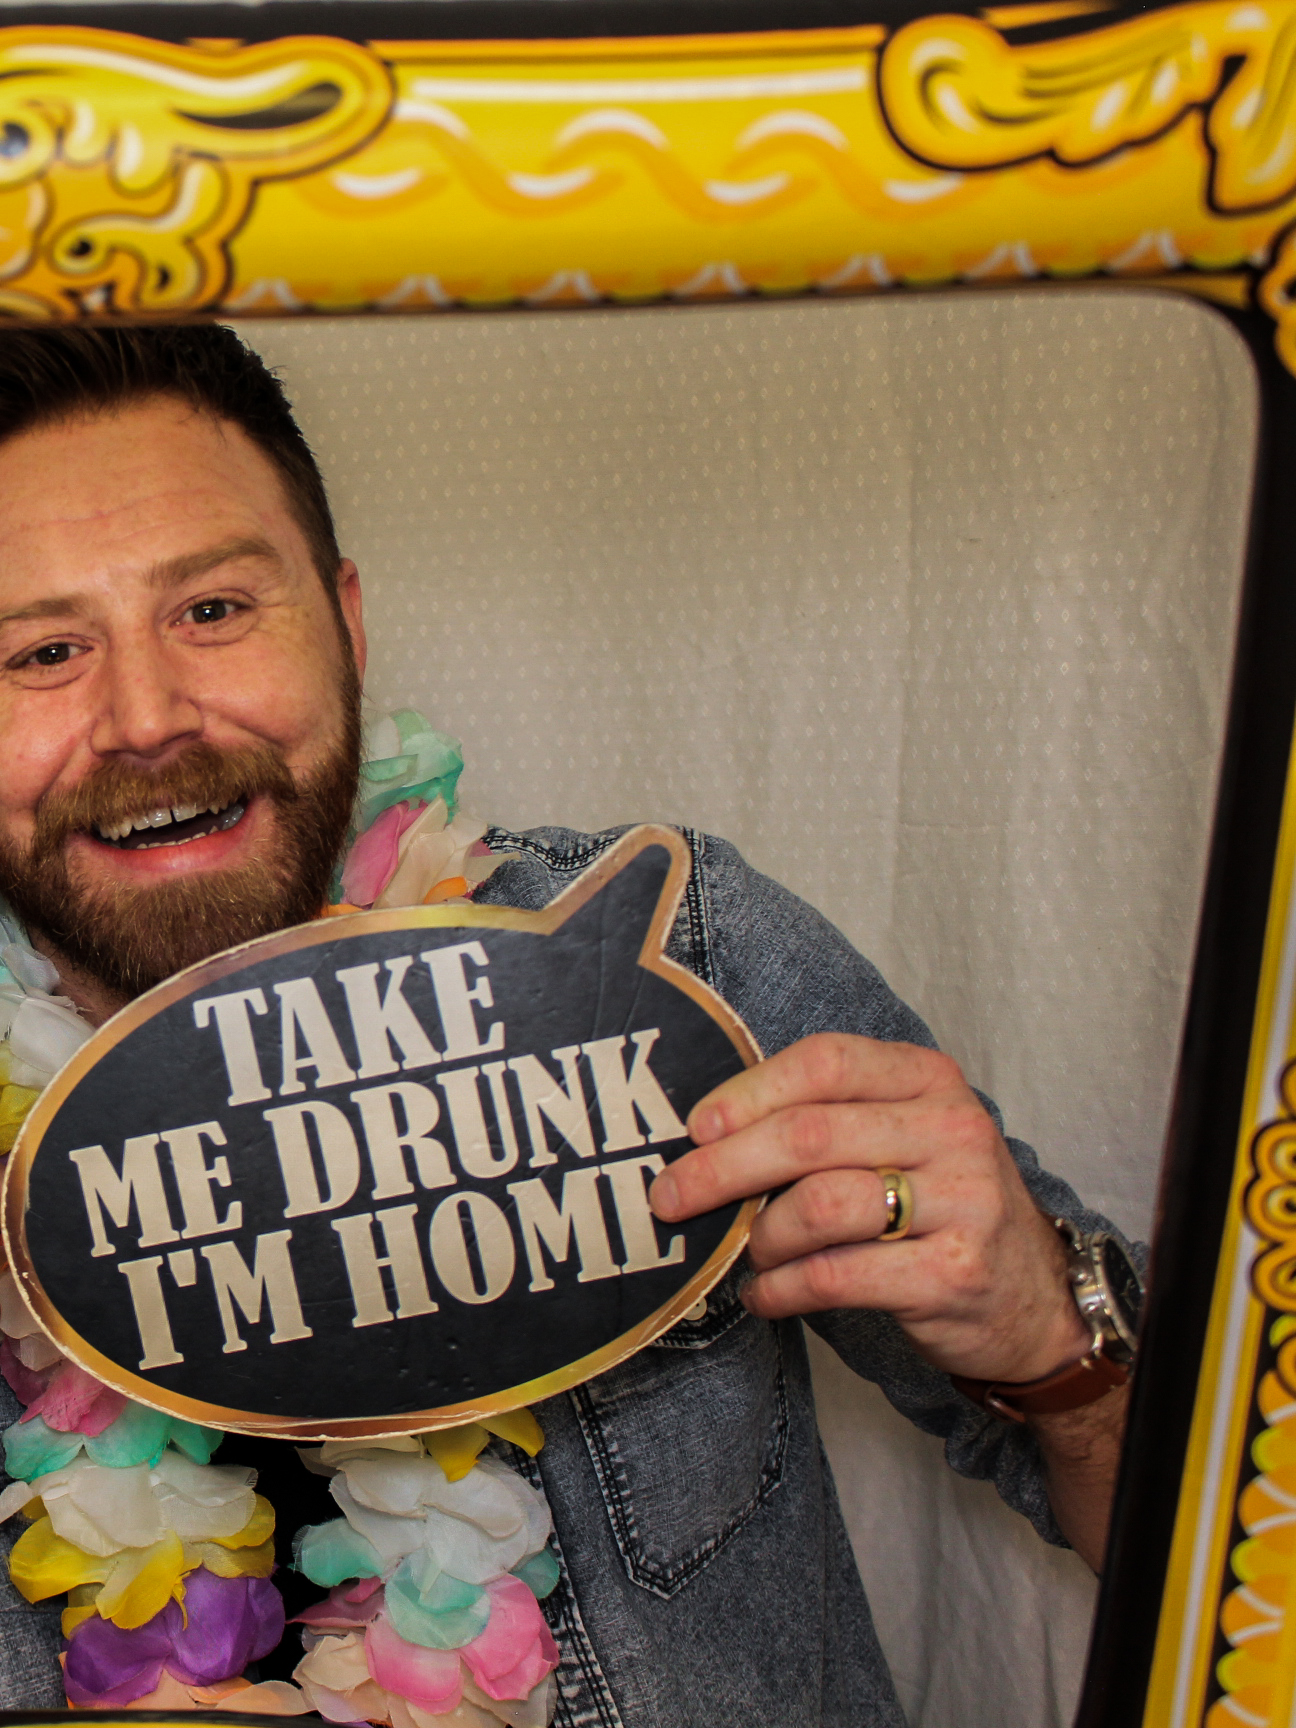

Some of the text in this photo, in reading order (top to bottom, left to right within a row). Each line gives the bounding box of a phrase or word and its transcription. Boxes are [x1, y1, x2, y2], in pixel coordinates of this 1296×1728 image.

[193, 940, 505, 1107] TAKE
[68, 1028, 690, 1258] ME DRUNK
[118, 1153, 686, 1371] I'M HOME
